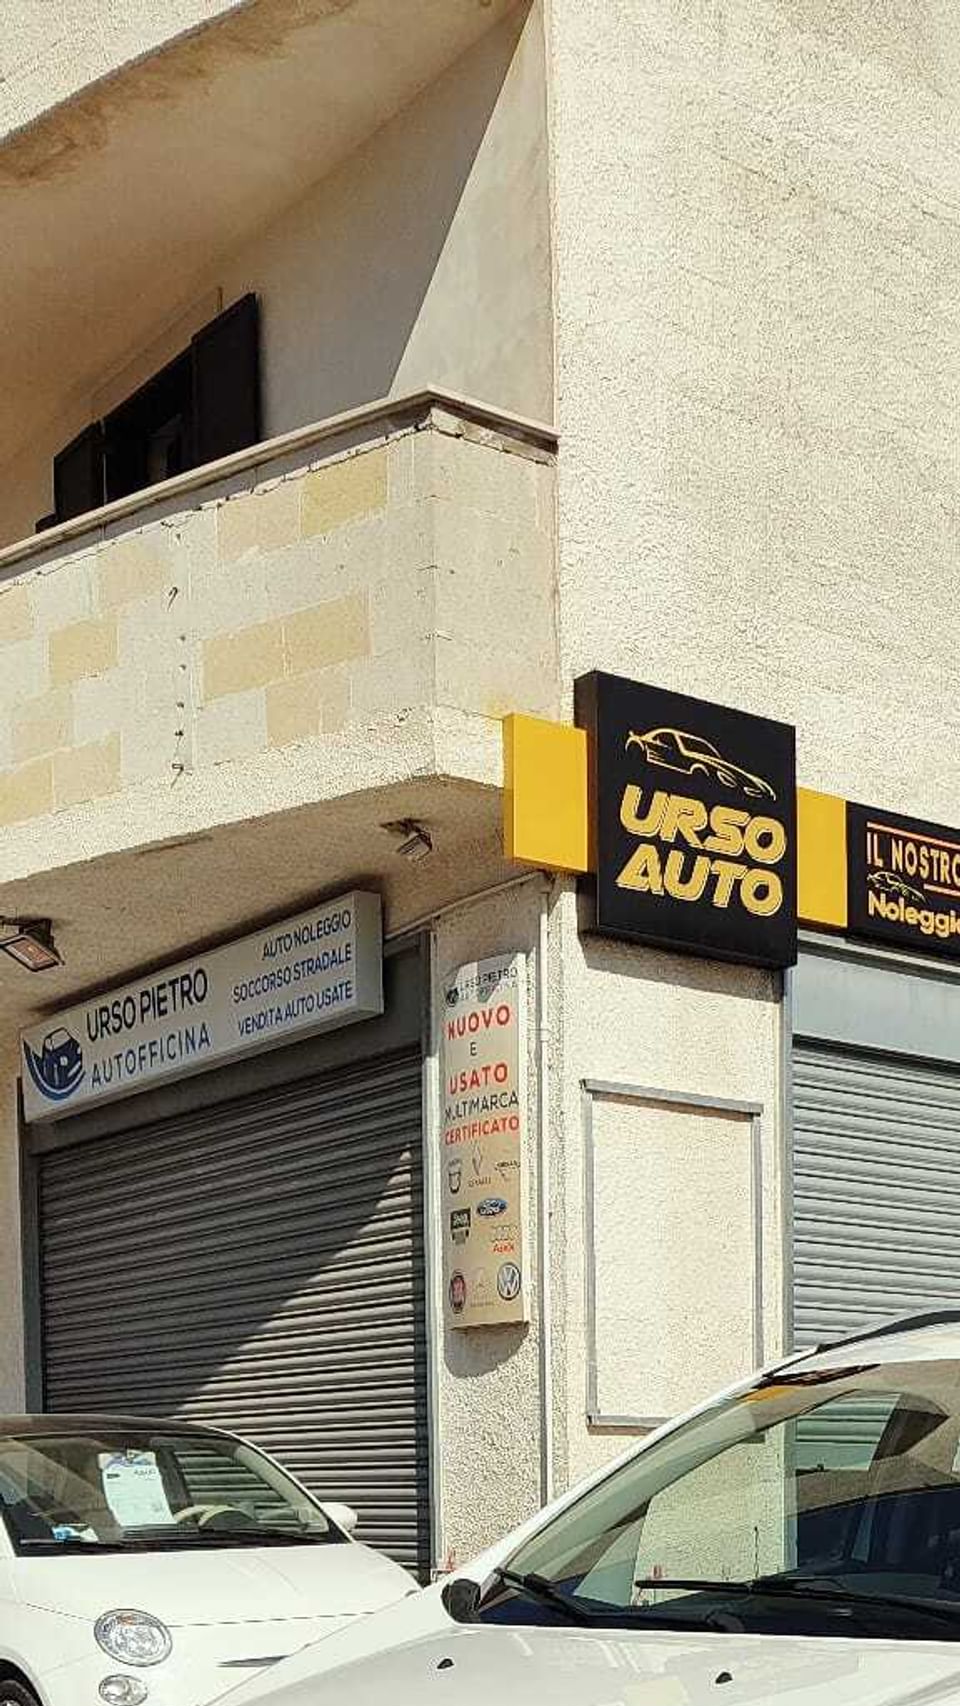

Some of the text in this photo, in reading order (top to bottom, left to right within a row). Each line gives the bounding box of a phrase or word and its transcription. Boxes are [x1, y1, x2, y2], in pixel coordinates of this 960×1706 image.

[619, 784, 787, 865] URSO
[866, 831, 883, 868] IL
[615, 843, 783, 917] AUTO
[233, 943, 352, 1004] SOCCORSO STRADALE
[86, 968, 208, 1042] URSO PIETRO
[238, 980, 353, 1037] VENDITA AUTO USATE
[448, 1004, 510, 1040] NUOVO
[91, 1021, 211, 1088] AUTOFFICINA
[470, 1042, 477, 1056] E
[449, 1063, 508, 1095] USATO
[445, 1115, 519, 1146] CERTIFICATO
